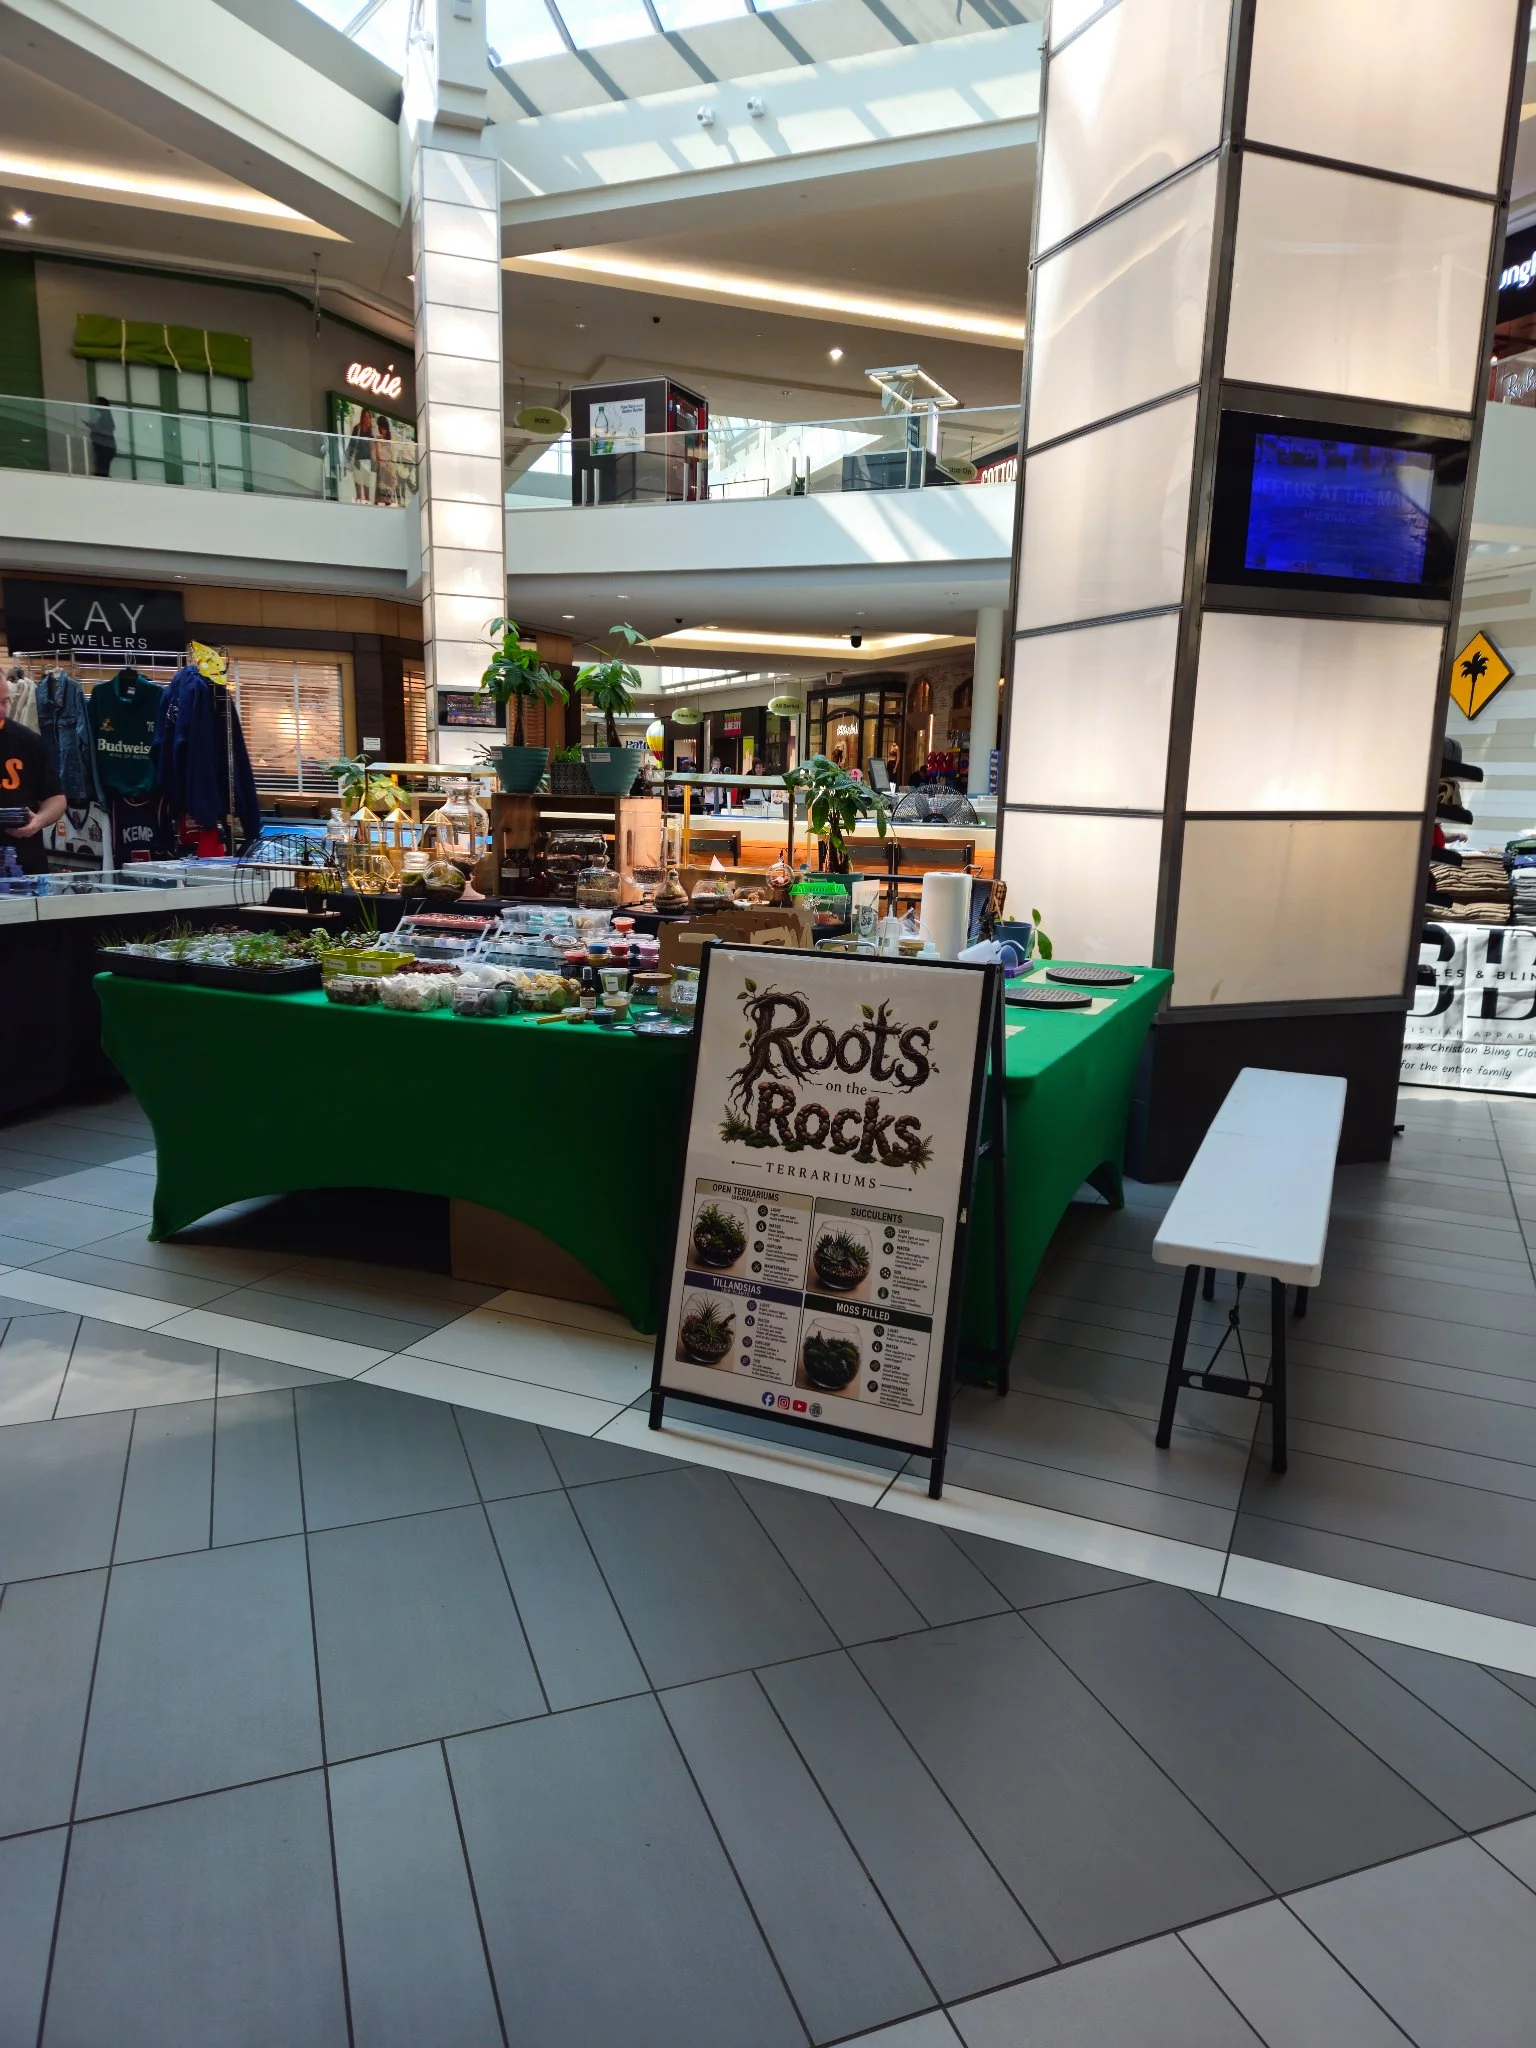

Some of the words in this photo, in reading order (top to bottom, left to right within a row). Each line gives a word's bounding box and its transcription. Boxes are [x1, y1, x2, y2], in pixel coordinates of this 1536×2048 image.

[346, 361, 402, 399] aerie
[1295, 481, 1317, 500] US
[1319, 484, 1340, 503] AT
[43, 597, 145, 634] KAY
[47, 632, 148, 650] JEWELERS
[1475, 970, 1484, 979] &
[1496, 971, 1536, 981] BLIN
[733, 988, 937, 1096] Roots
[1411, 1027, 1463, 1037] ISTIAN
[1473, 1031, 1536, 1041] APPARE
[1416, 1043, 1425, 1051] &
[1430, 1043, 1478, 1055] Christian
[1483, 1046, 1511, 1059] Bling
[1399, 1060, 1416, 1069] for
[1420, 1061, 1438, 1071] the
[1442, 1065, 1473, 1075] entire
[1477, 1066, 1512, 1080] family
[826, 1081, 842, 1092] on
[846, 1082, 868, 1096] the
[754, 1081, 923, 1161] Rocks
[766, 1161, 877, 1189] TERRARIUMS
[712, 1183, 732, 1194] OPEN
[733, 1186, 780, 1202] TERRARIUMS
[850, 1206, 904, 1224] SUCCULENTS
[712, 1277, 762, 1294] TILLANDSIAS
[836, 1302, 861, 1317] MOSS
[862, 1305, 891, 1321] FILLED
